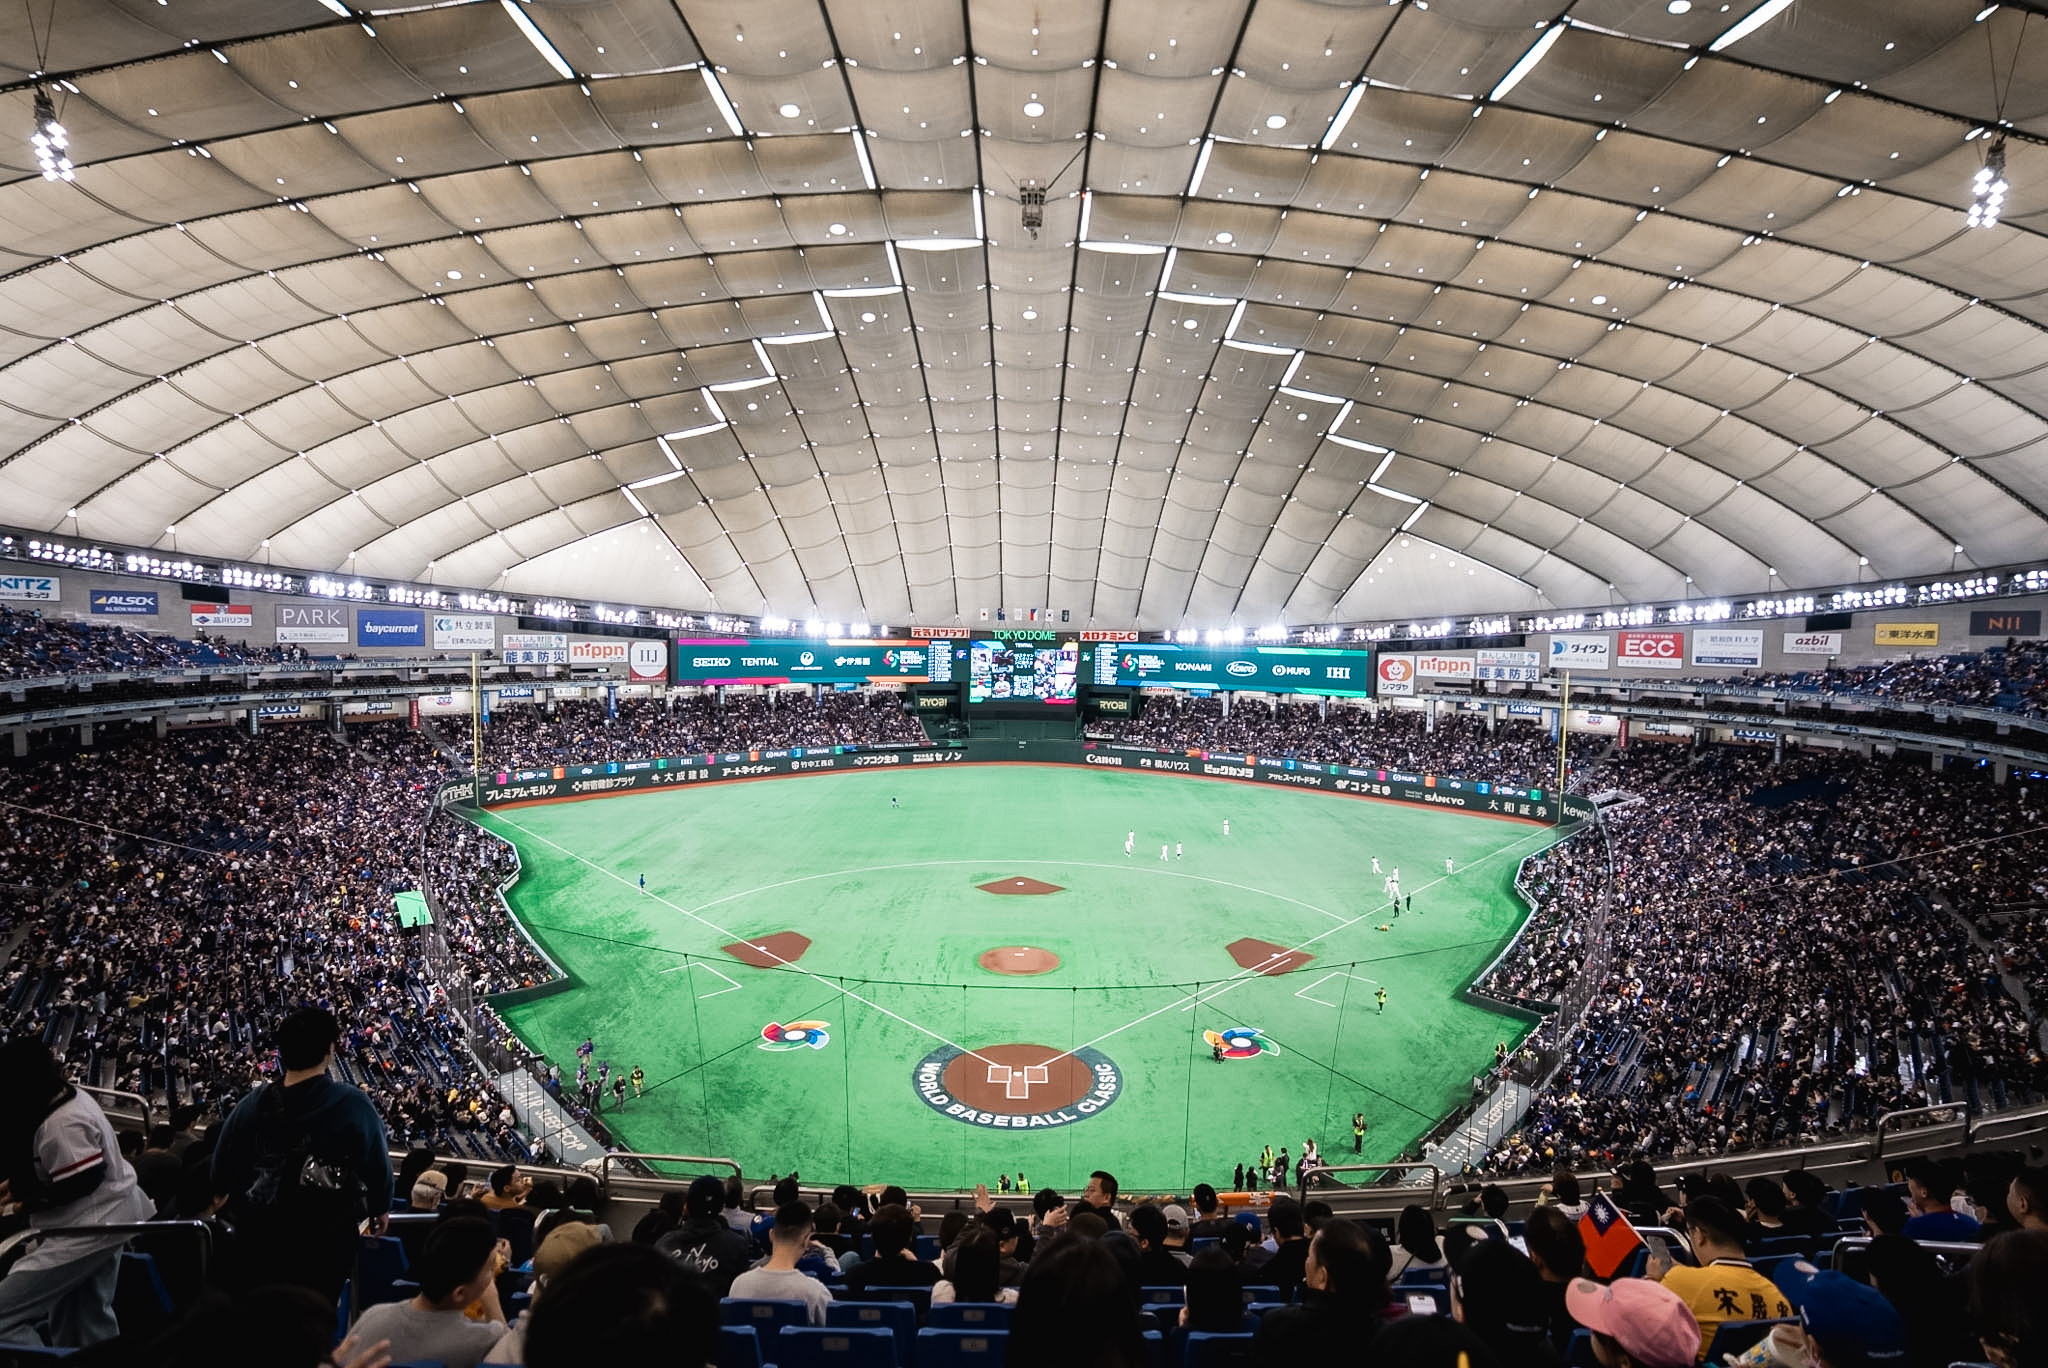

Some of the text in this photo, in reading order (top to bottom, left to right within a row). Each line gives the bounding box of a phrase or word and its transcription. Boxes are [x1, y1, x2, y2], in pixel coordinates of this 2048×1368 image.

[0, 578, 51, 590] KITZ
[282, 608, 341, 625] PARK
[365, 621, 418, 635] baycurrent
[993, 631, 1056, 640] TOKYO DOME
[1082, 632, 1137, 640] オロナミンC
[1889, 630, 1936, 639] 東洋水産
[1795, 635, 1829, 646] azbil
[573, 643, 624, 658] nippn
[1625, 639, 1675, 657] ECC
[506, 651, 565, 663] 能美防災
[692, 657, 731, 667] SEIKO
[740, 658, 779, 667] TENTIAL
[1175, 662, 1212, 672] KONAMI
[1420, 657, 1471, 673] nippn
[1286, 667, 1311, 676] MUFG
[1326, 666, 1350, 679] IHI
[1478, 667, 1537, 680] 能美防災
[500, 688, 532, 697] SAISON
[920, 698, 947, 707] RYOBI
[1100, 701, 1127, 710] RYOBI
[1510, 705, 1541, 714] SAISON
[863, 755, 899, 765] フコク生命
[1085, 754, 1122, 765] Canon
[664, 769, 709, 782] 大成建設
[1424, 793, 1466, 806] SANKYO
[1488, 799, 1548, 818] 大和証券
[918, 1062, 1117, 1128] WORLD BASEBALL CLASSIC
[1456, 1126, 1488, 1150] AIR
